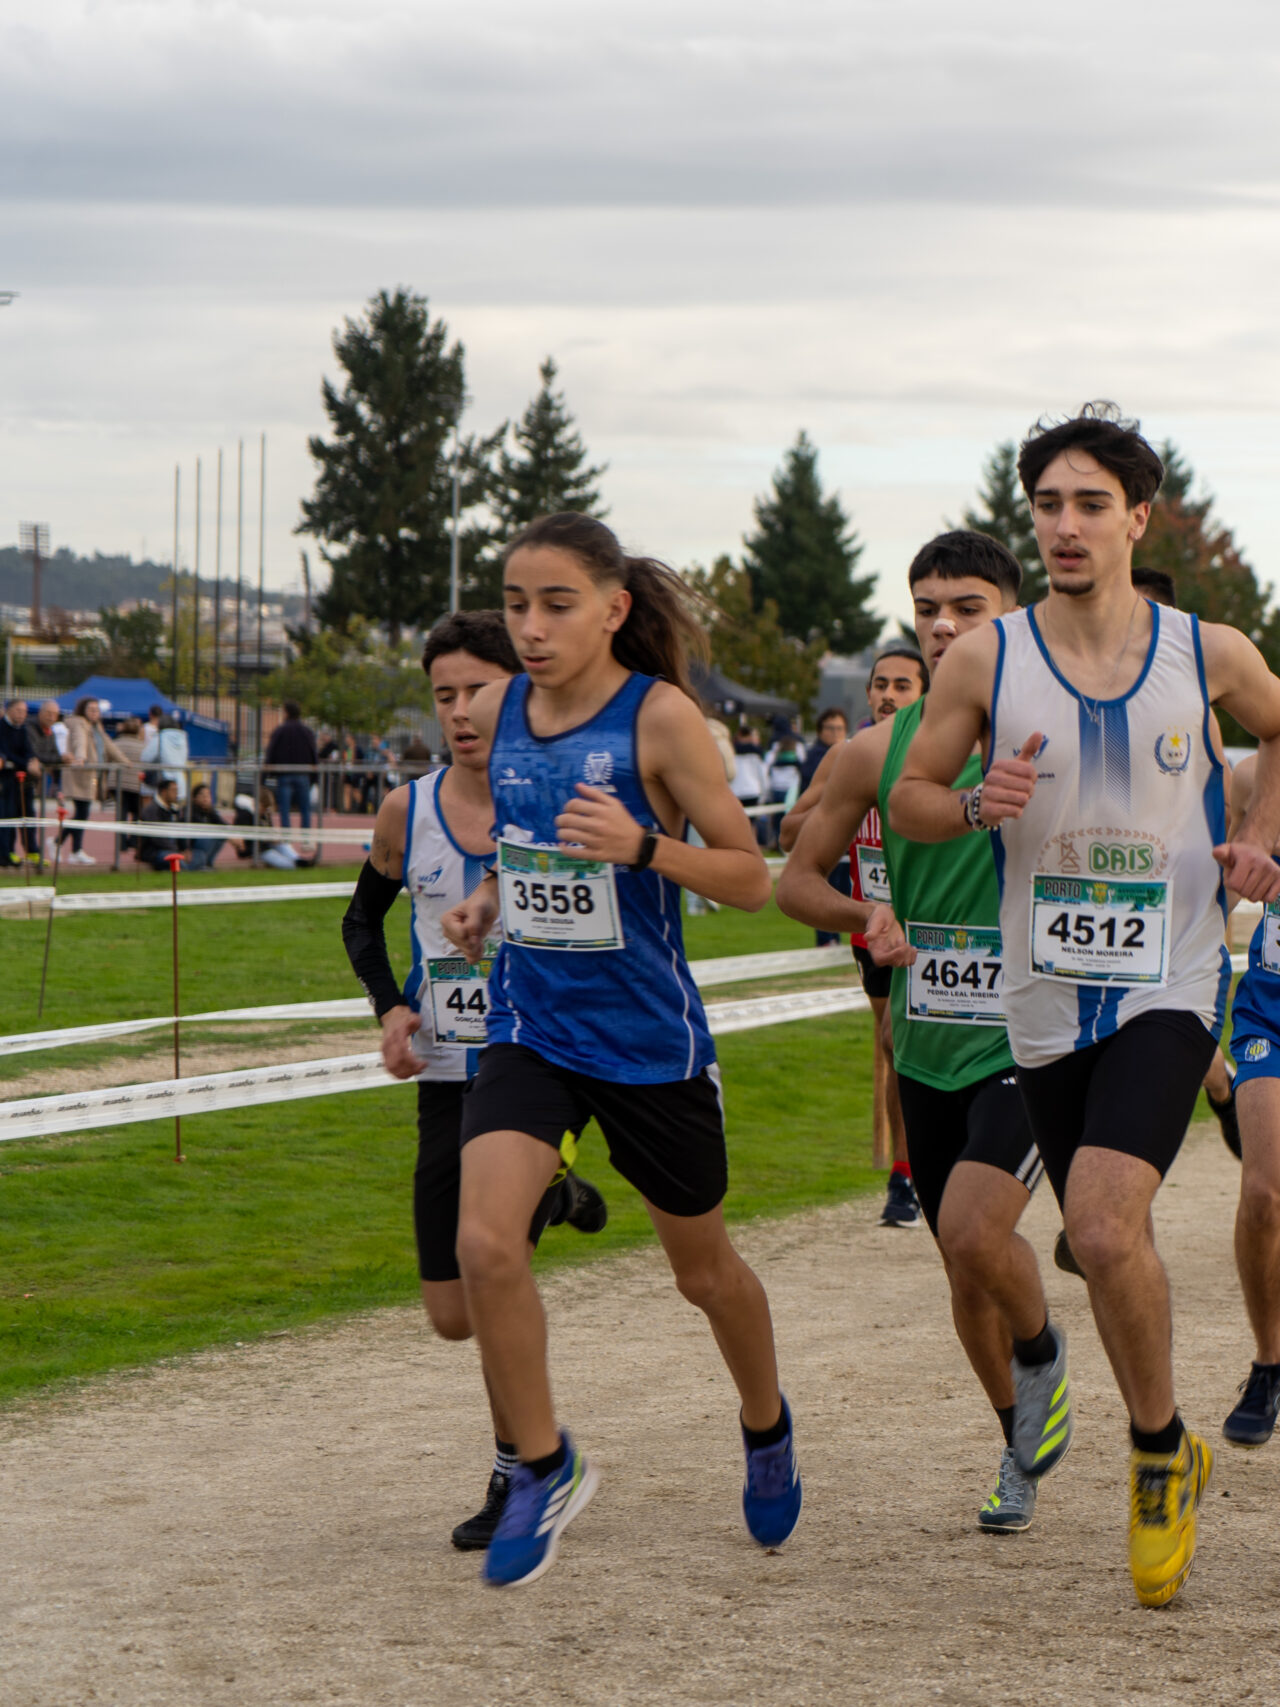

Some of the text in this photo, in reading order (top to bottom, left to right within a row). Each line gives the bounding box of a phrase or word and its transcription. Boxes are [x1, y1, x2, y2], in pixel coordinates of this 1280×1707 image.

[1090, 844, 1151, 873] DAIS
[513, 880, 594, 914] 3558
[1044, 881, 1081, 898] PORTO
[917, 930, 945, 945] PORTO
[1048, 912, 1145, 948] 4512
[1061, 946, 1134, 957] NELSON MOREIRA
[437, 962, 470, 975] PORTO
[921, 959, 1002, 990] 4647
[446, 987, 487, 1014] 44
